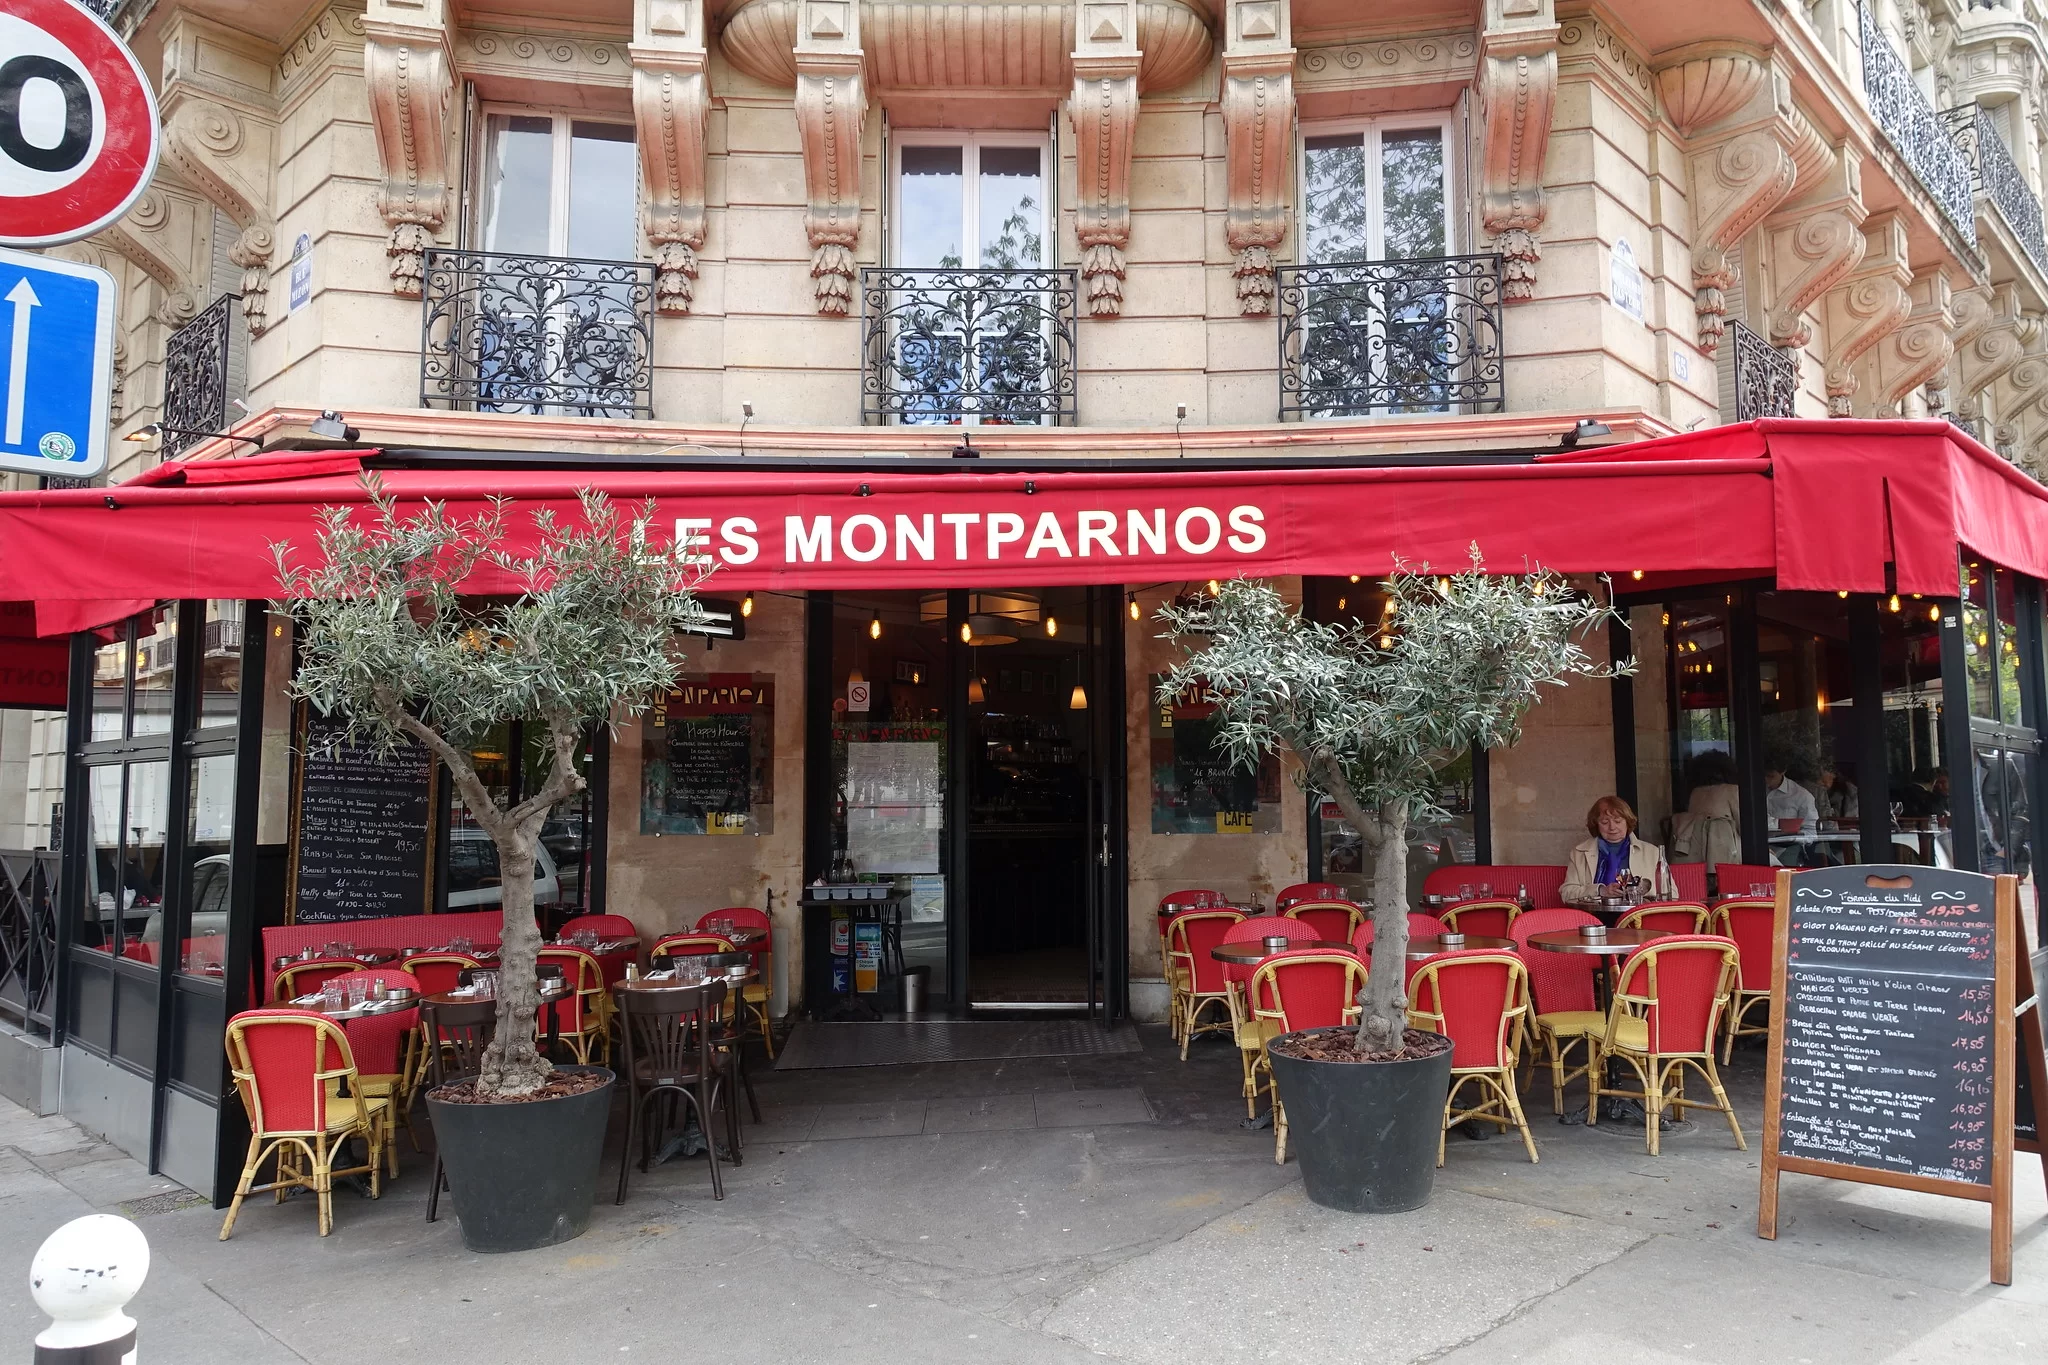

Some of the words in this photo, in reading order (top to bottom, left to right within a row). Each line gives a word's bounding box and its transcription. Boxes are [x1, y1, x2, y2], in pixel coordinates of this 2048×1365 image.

[1675, 352, 1688, 379] 65
[632, 515, 760, 567] LES
[785, 504, 1268, 564] MONTPARNOS
[686, 722, 718, 739] Happy
[718, 723, 739, 737] Hour
[1839, 891, 1879, 902] Formule
[1884, 893, 1900, 902] du
[1903, 893, 1922, 902] Midi
[1802, 921, 1827, 930] GIGOT
[1829, 922, 1866, 932] D'AGNEAU
[1890, 927, 1902, 935] ET
[1902, 927, 1920, 935] SON
[1920, 929, 1936, 937] JUS
[1936, 930, 1971, 939] CROZETS
[1801, 936, 1825, 945] STEAK
[1838, 939, 1859, 947] THON
[1859, 939, 1889, 949] GRILLÉ
[1901, 940, 1934, 952] SÉSAME
[1937, 943, 1977, 953] LÉGUMES
[1816, 945, 1862, 955] CROQUANTS
[1800, 984, 1836, 993] HARICOTS
[1841, 986, 1870, 995] VERTS
[1836, 996, 1847, 1004] DE
[1873, 1000, 1884, 1008] DE
[1791, 1038, 1827, 1050] BURGER
[1830, 1061, 1841, 1070] DE
